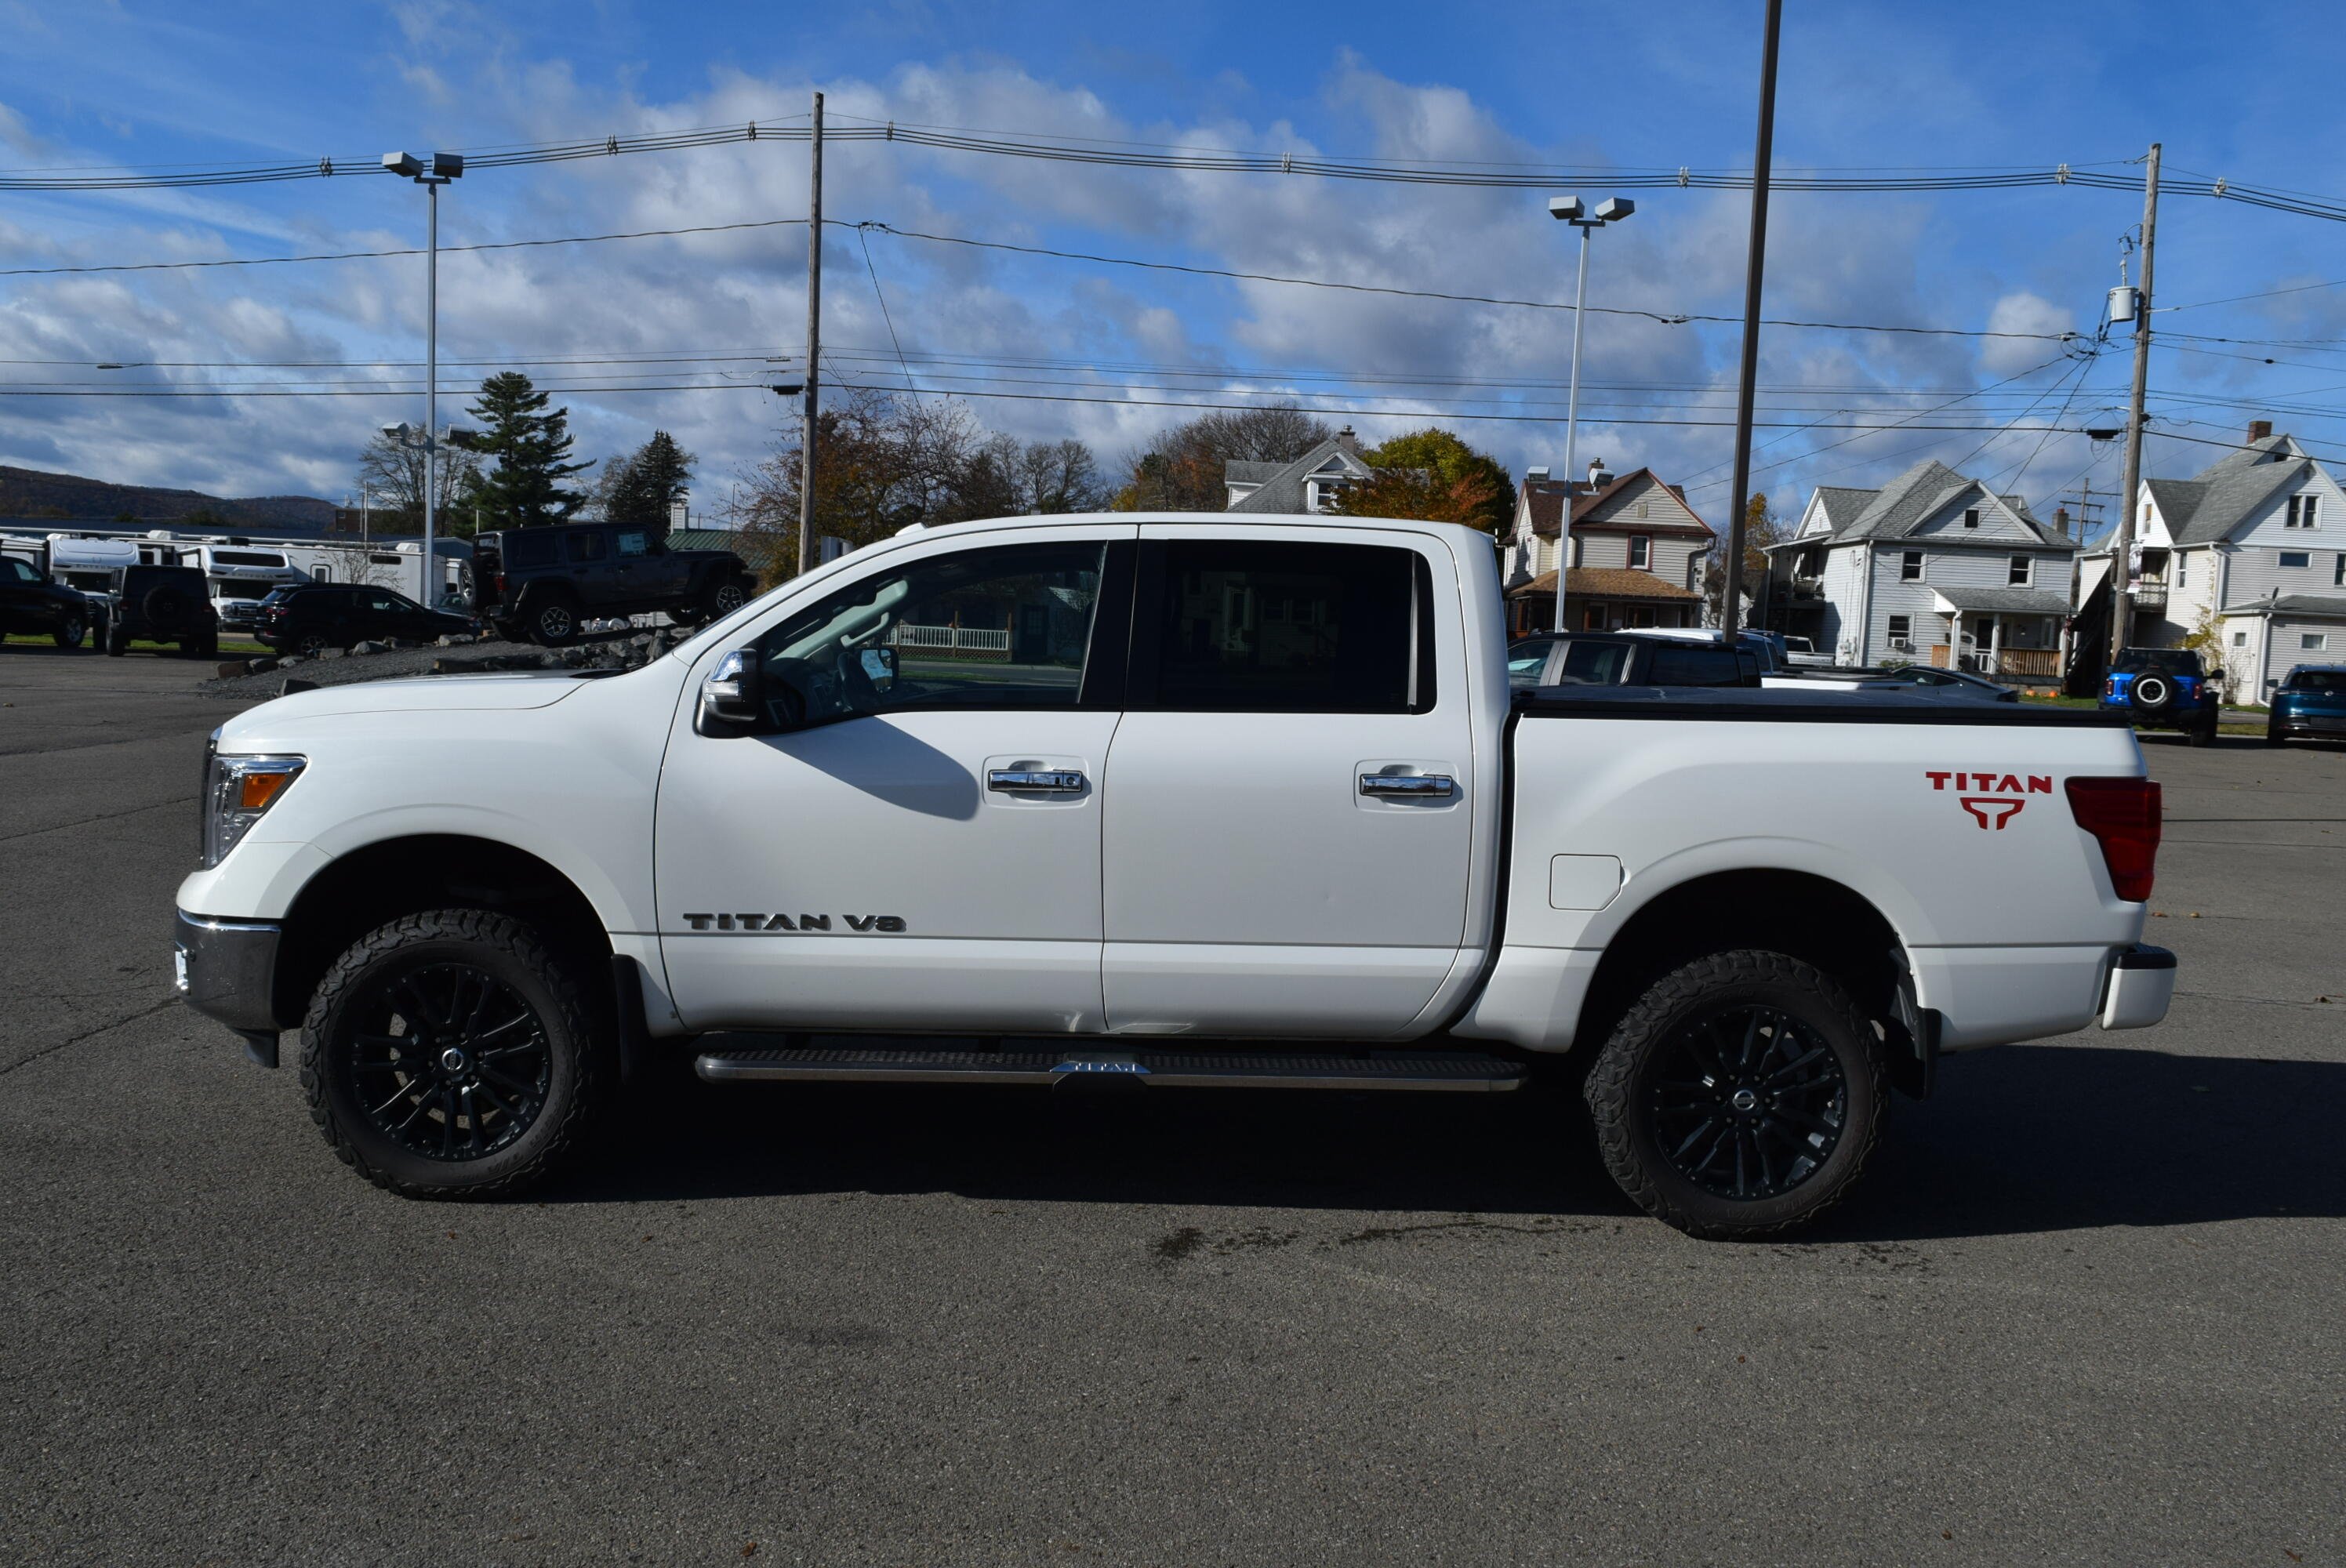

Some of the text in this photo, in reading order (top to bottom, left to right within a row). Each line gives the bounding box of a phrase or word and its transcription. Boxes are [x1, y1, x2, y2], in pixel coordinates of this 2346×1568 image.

[1926, 771, 2052, 793] TITAN
[683, 913, 906, 932] TITAN V8
